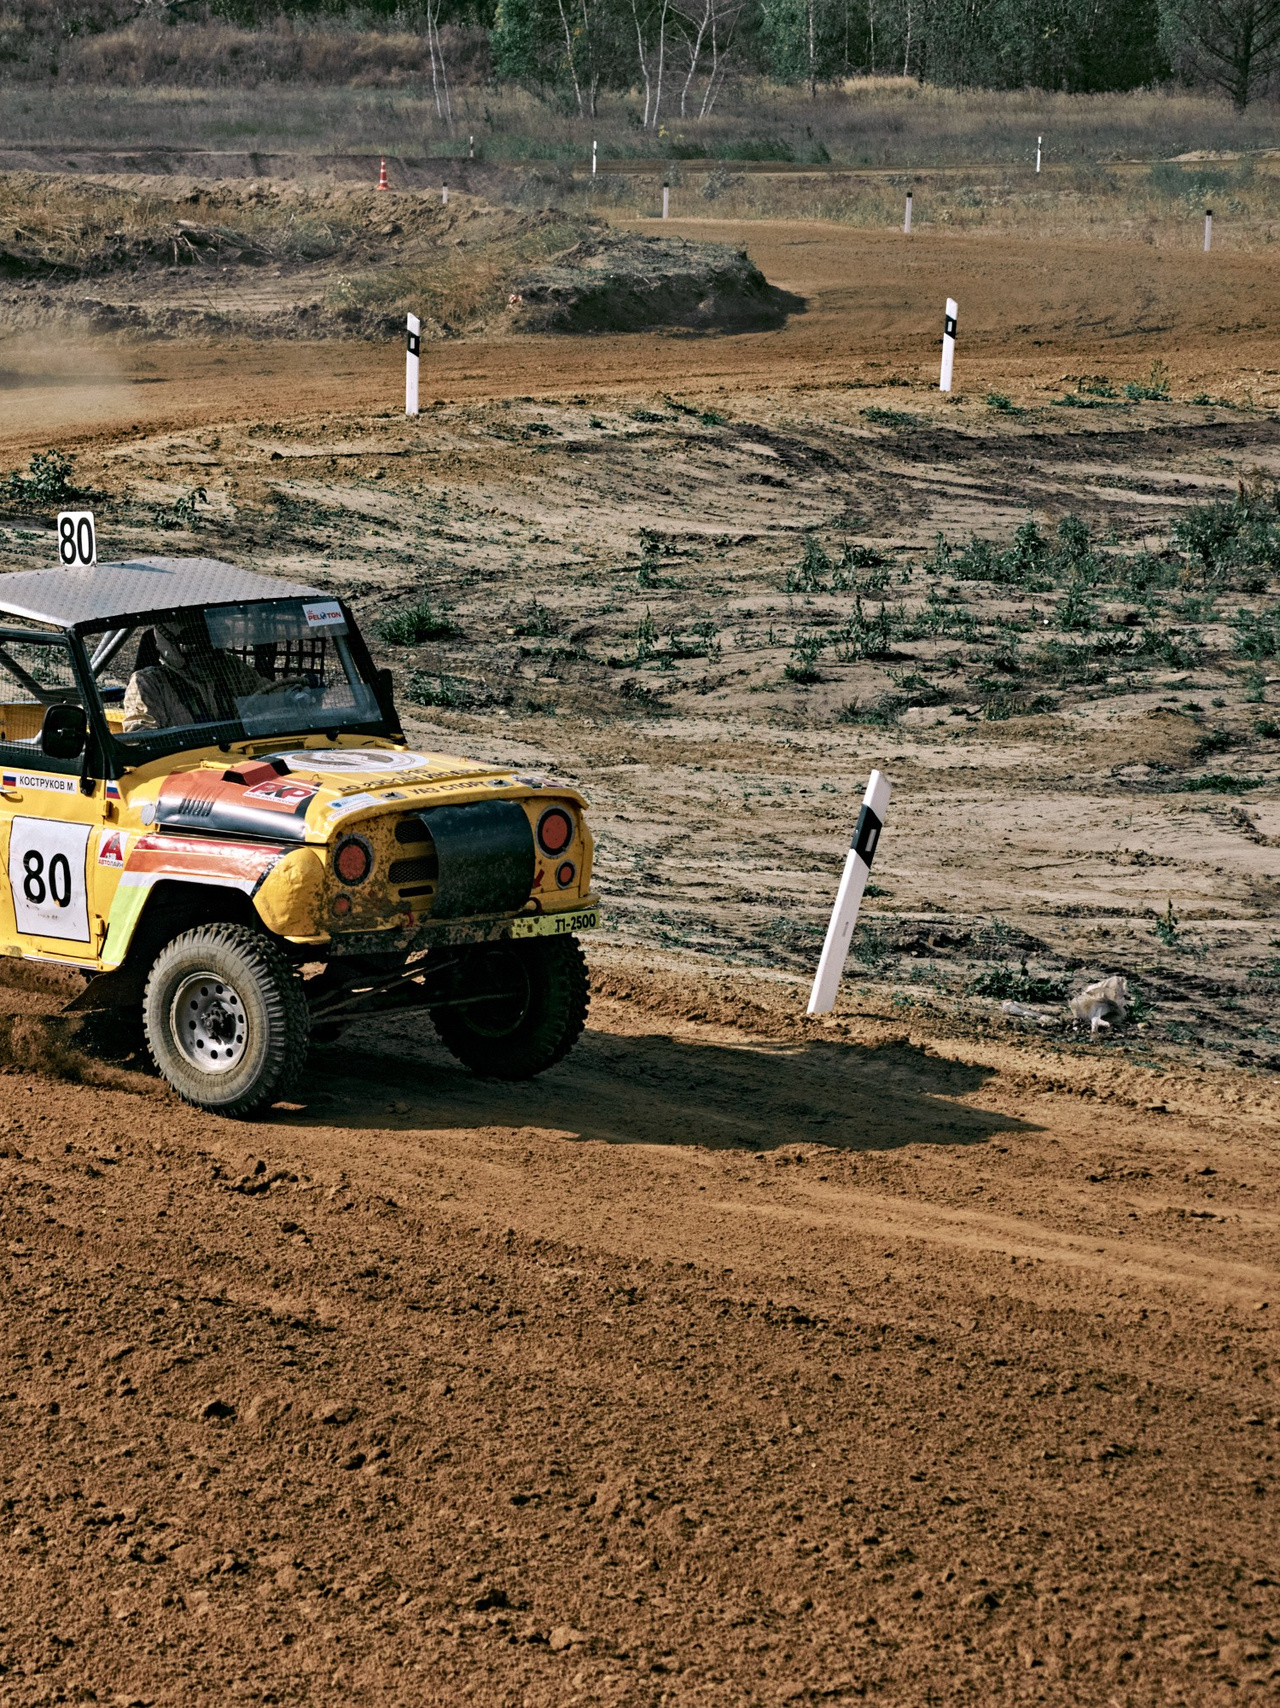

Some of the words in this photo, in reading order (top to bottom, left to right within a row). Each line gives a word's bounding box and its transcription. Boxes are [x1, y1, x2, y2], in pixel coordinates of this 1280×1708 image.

[60, 517, 94, 565] 80
[19, 776, 65, 790] КОСТРУКОВ
[408, 787, 440, 795] УАЗ
[440, 781, 488, 791] СПОРТ
[23, 849, 71, 908] 80
